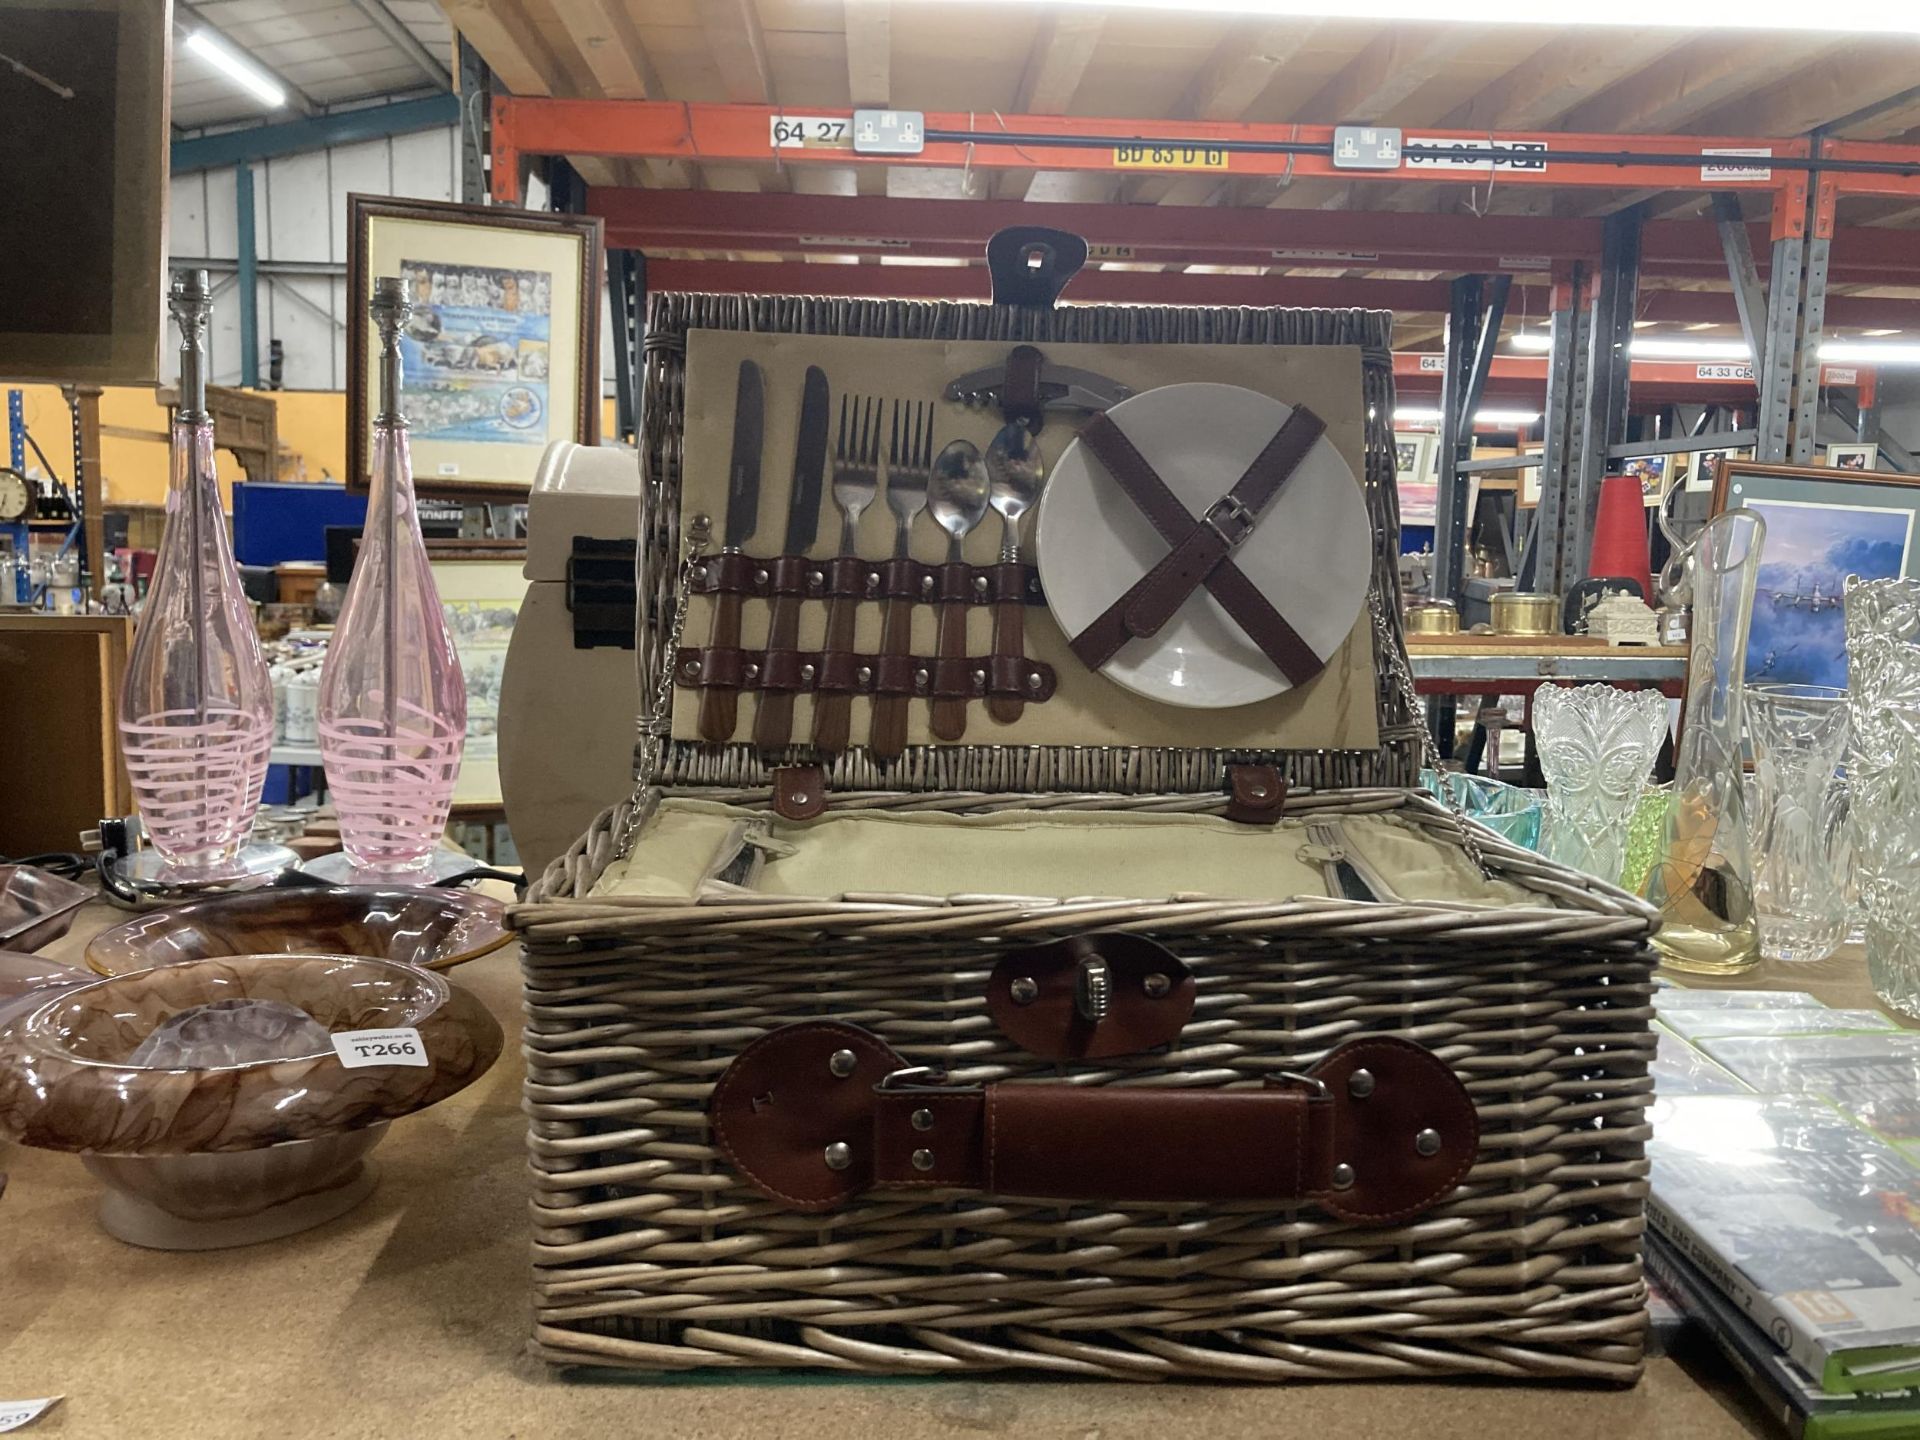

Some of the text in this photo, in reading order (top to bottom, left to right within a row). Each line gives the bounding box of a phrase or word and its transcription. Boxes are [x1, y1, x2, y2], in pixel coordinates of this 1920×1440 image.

[773, 121, 846, 142] 64 27
[1698, 367, 1713, 377] 64
[1717, 367, 1731, 378] 33
[355, 1042, 416, 1057] T266
